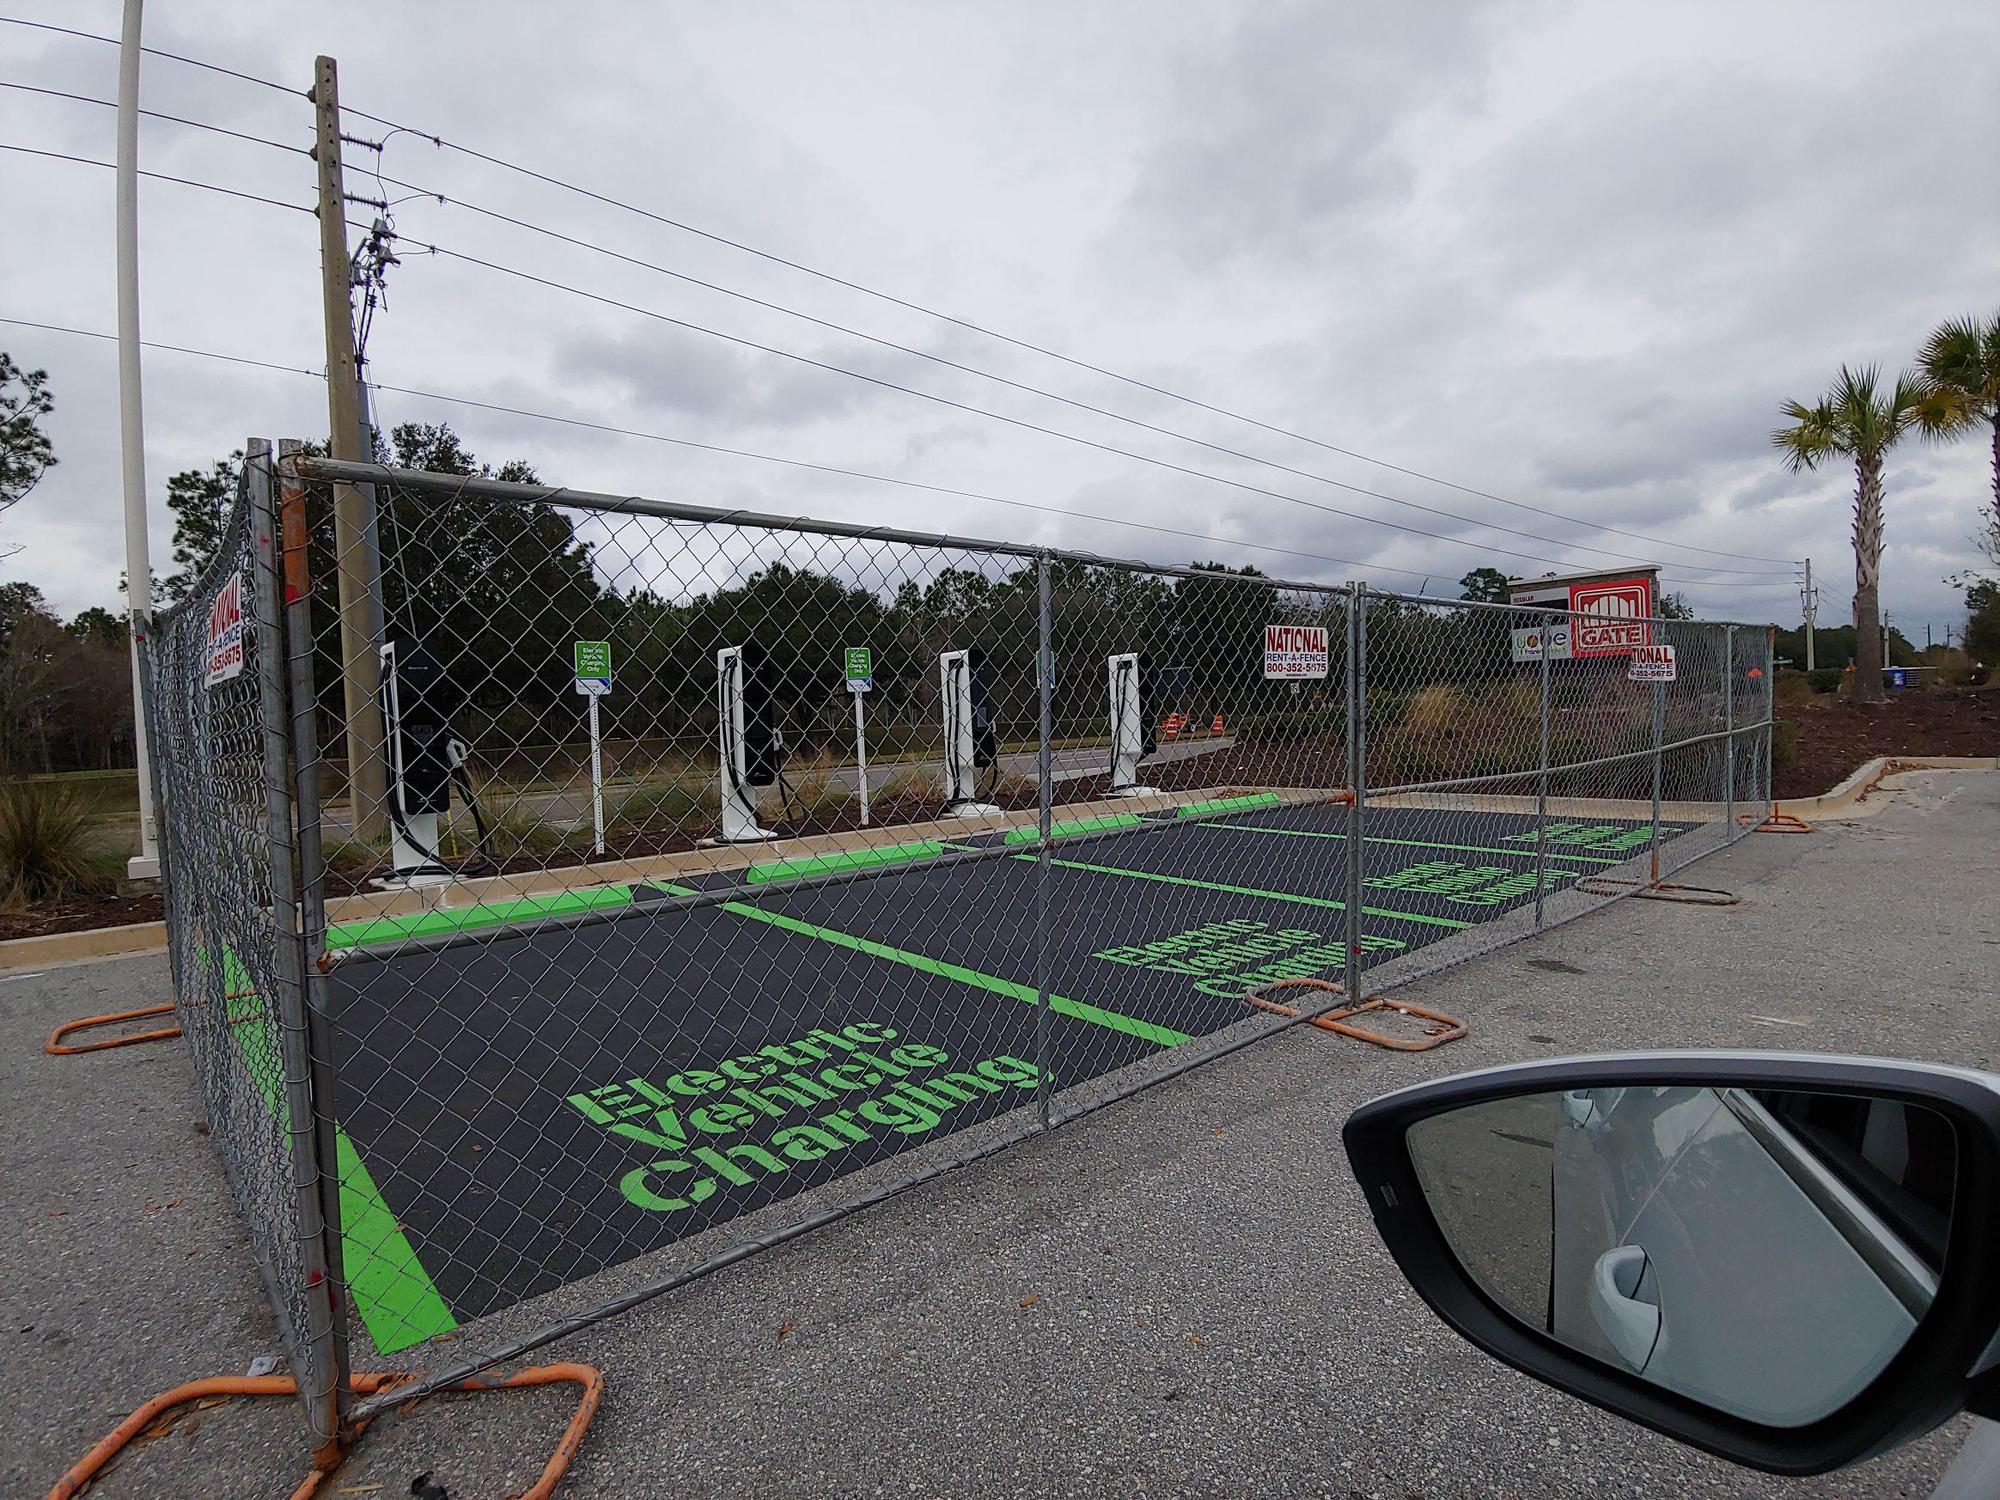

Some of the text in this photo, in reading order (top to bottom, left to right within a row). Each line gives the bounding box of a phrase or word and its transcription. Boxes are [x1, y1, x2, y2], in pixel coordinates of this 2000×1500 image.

[1266, 653, 1327, 662] RENT-A-FENCE
[1267, 627, 1327, 653] NATIONAL
[1581, 626, 1641, 646] GATE
[1266, 663, 1327, 672] 800-352-5675
[1091, 918, 1269, 967] Electric
[1144, 929, 1321, 977] Vehicle
[566, 1022, 898, 1125] Electric
[608, 1043, 949, 1151] Vehicle
[619, 1054, 1056, 1213] Charging
